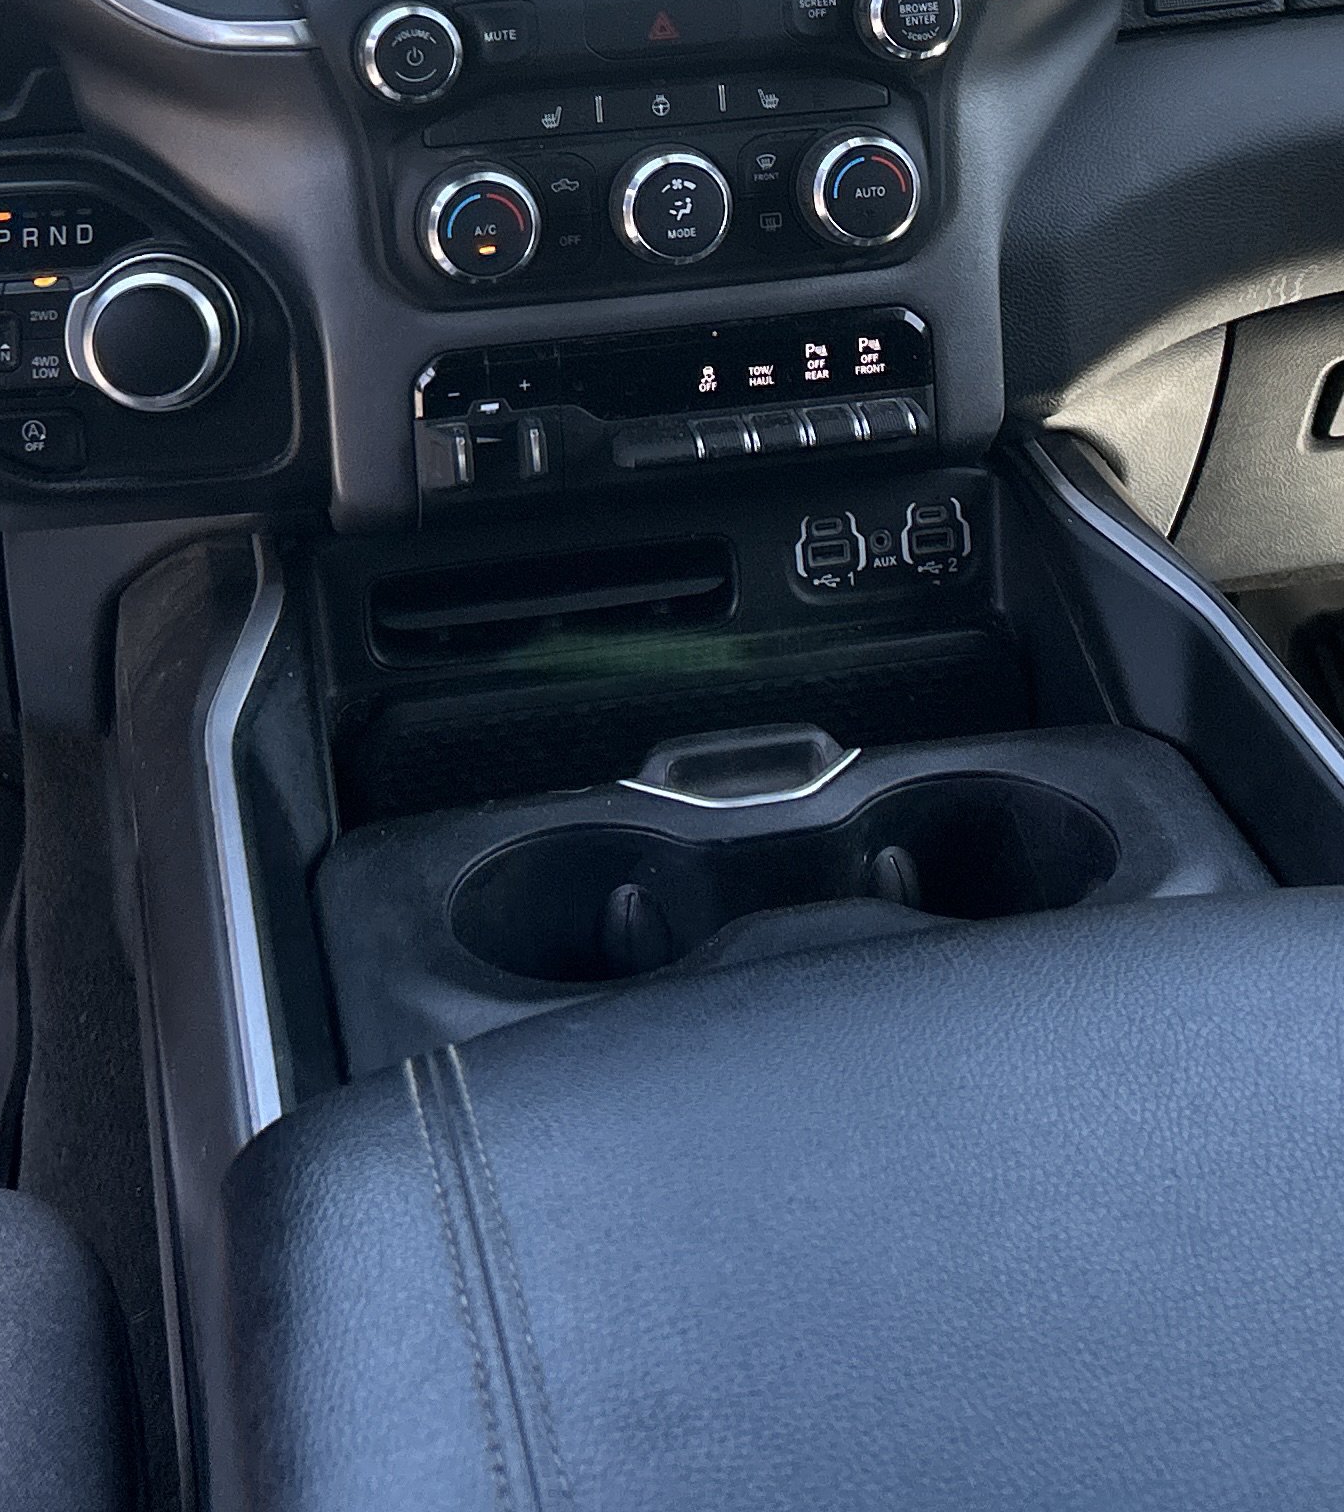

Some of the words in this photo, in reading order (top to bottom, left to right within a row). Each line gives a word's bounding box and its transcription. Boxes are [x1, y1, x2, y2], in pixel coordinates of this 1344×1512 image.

[808, 8, 827, 19] OFF
[899, 1, 939, 14] BROWSE
[906, 13, 937, 26] ENTER
[397, 29, 431, 42] VOLUME
[484, 29, 517, 42] MUTE
[907, 30, 937, 41] SCROLL
[754, 172, 779, 181] FRONT
[855, 186, 886, 199] AUTO
[22, 227, 39, 248] R
[49, 225, 67, 245] N
[76, 223, 93, 244] D
[474, 224, 497, 236] A/C
[667, 227, 697, 239] MODE
[559, 235, 582, 247] OFF
[30, 310, 58, 322] 2WD
[0, 350, 10, 362] N
[32, 355, 59, 367] 4WD
[860, 353, 878, 364] OFF
[748, 365, 774, 376] TOW/
[807, 359, 826, 370] OFF
[855, 363, 886, 375] FRONT
[32, 367, 59, 379] LOW
[805, 369, 829, 381] REAR
[698, 382, 718, 393] OFF
[749, 376, 775, 387] HAUL
[24, 442, 45, 452] OFF
[873, 556, 897, 568] AUX
[948, 558, 958, 572] 2
[847, 572, 855, 587] 1
